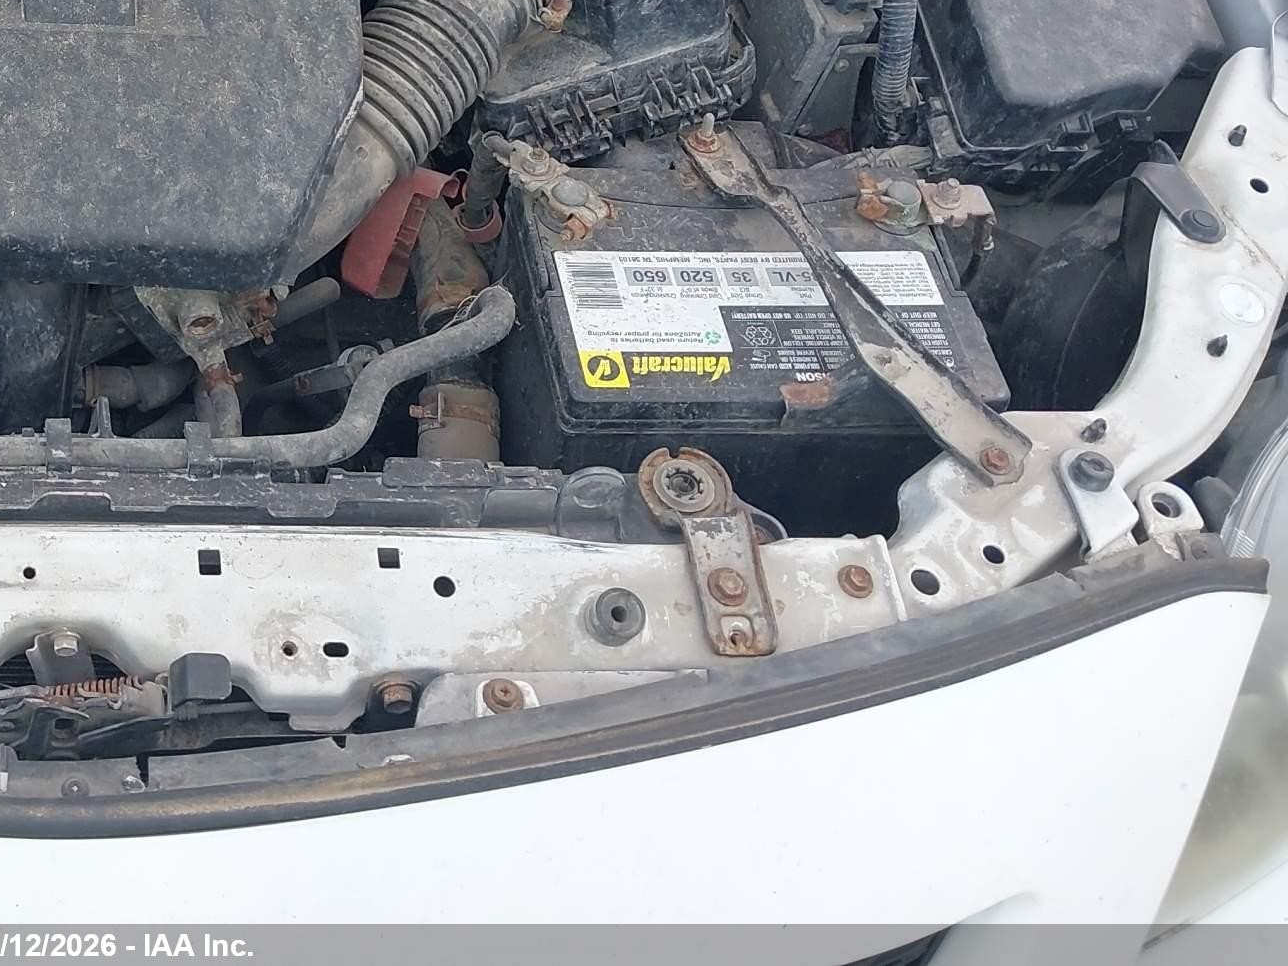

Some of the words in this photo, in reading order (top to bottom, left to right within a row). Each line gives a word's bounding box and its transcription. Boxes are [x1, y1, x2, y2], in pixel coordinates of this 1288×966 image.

[771, 256, 809, 264] TRIBUTED
[632, 270, 667, 283] 650
[680, 270, 714, 283] 520
[731, 271, 751, 283] 35
[587, 330, 622, 338] recycling
[631, 355, 732, 383] Valucraft
